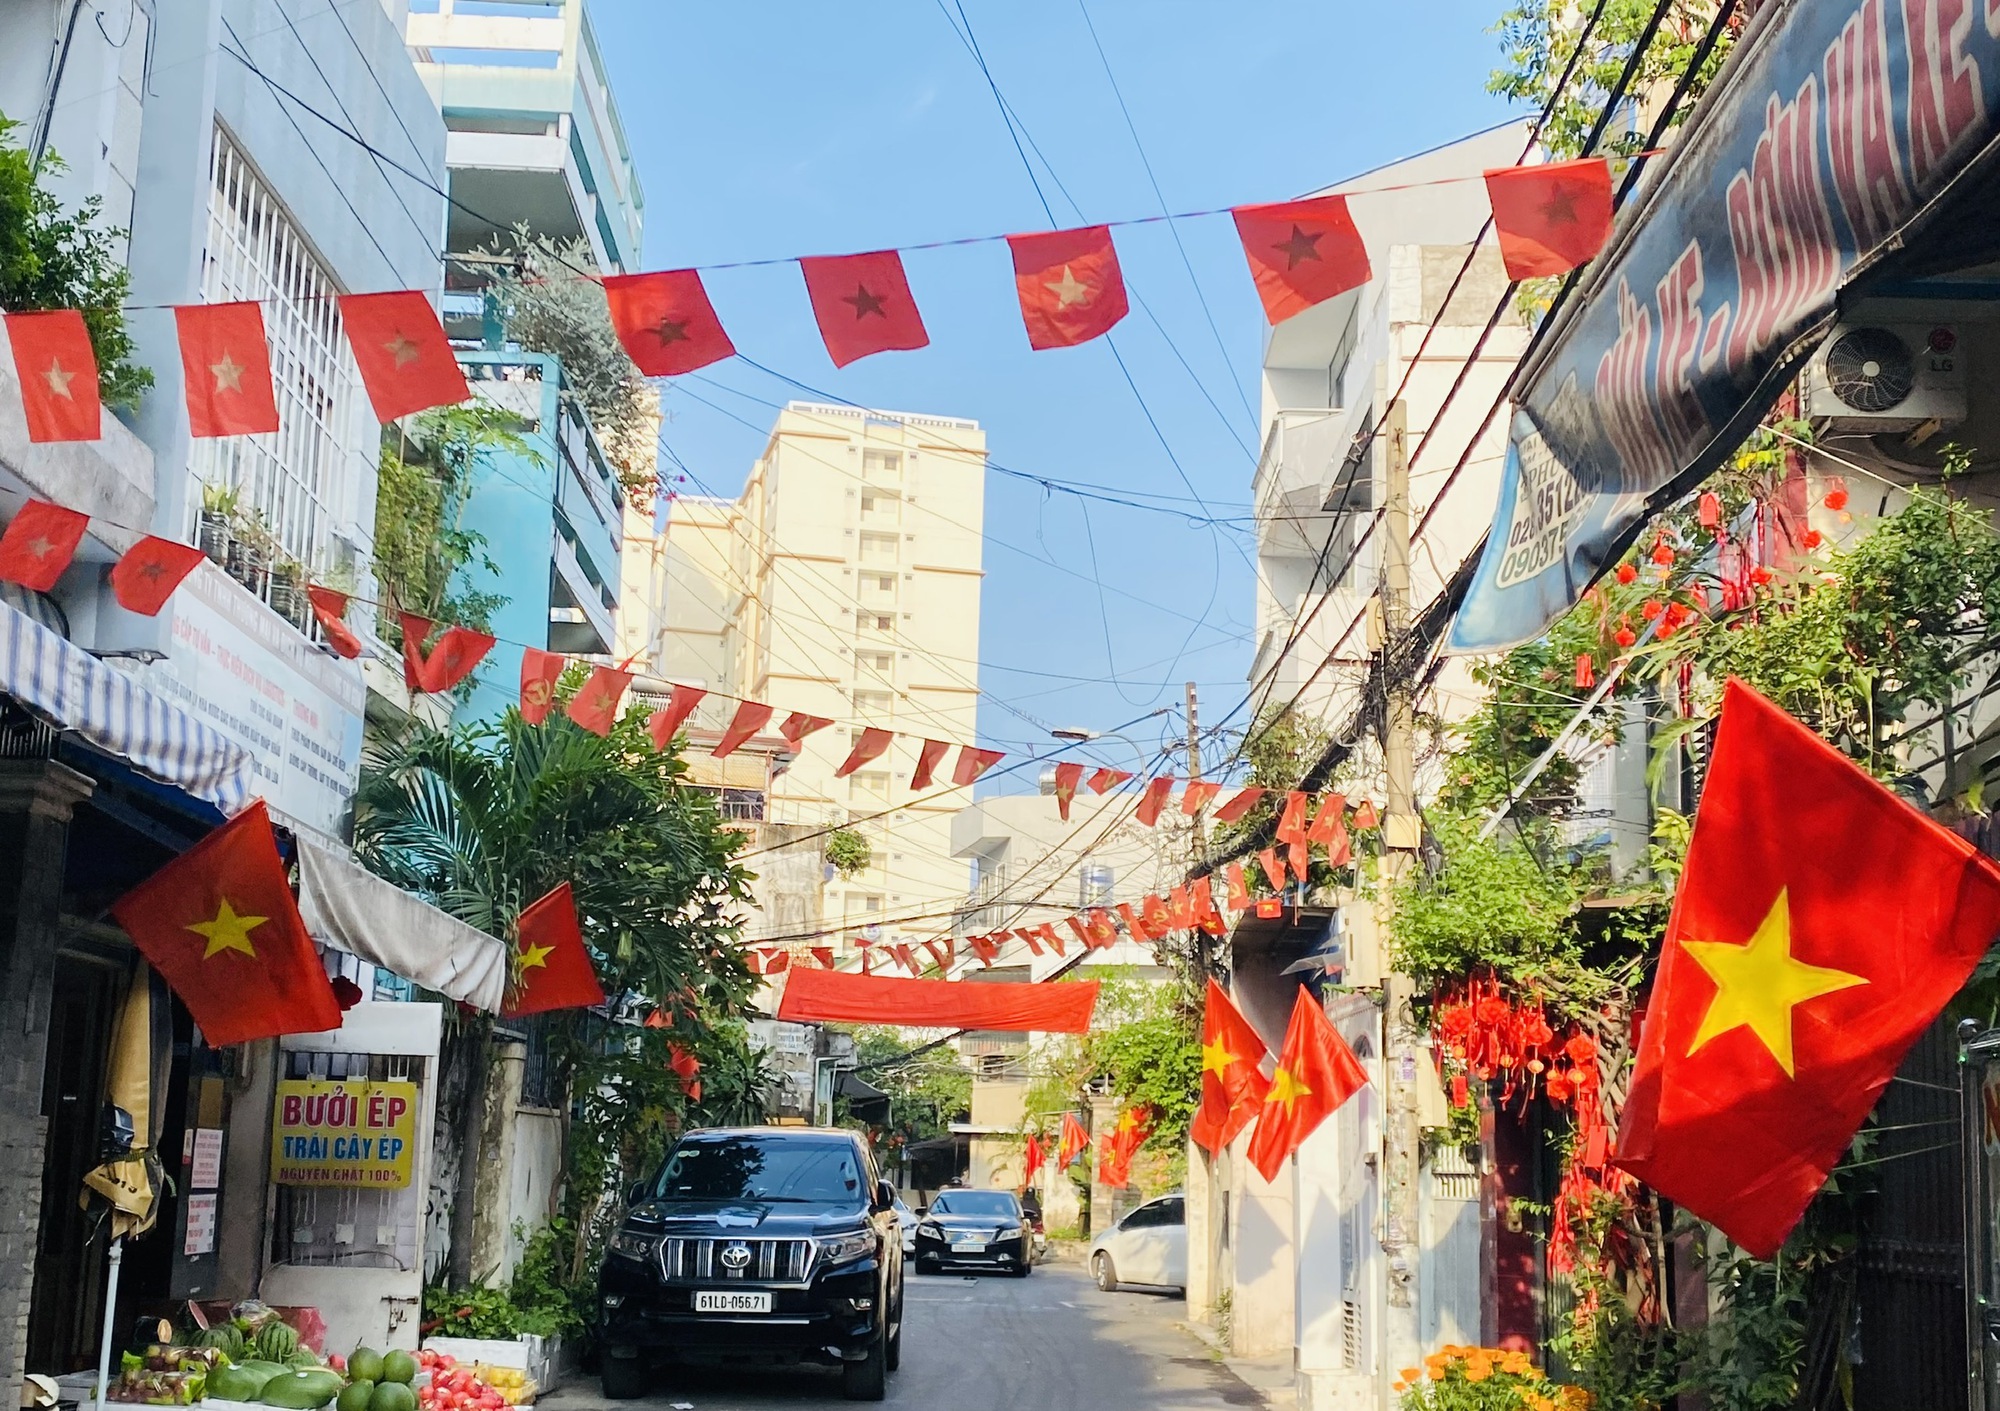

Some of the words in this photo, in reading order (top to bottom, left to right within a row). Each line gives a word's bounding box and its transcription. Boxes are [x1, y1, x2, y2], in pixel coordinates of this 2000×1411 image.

[1931, 359, 1953, 371] LG
[282, 1084, 358, 1128] BƯỞI
[367, 1090, 407, 1128] ÉP
[284, 1132, 328, 1159] TRÁI
[334, 1132, 373, 1160] CÂY
[378, 1133, 403, 1160] ÉP
[368, 1169, 402, 1182] 100%
